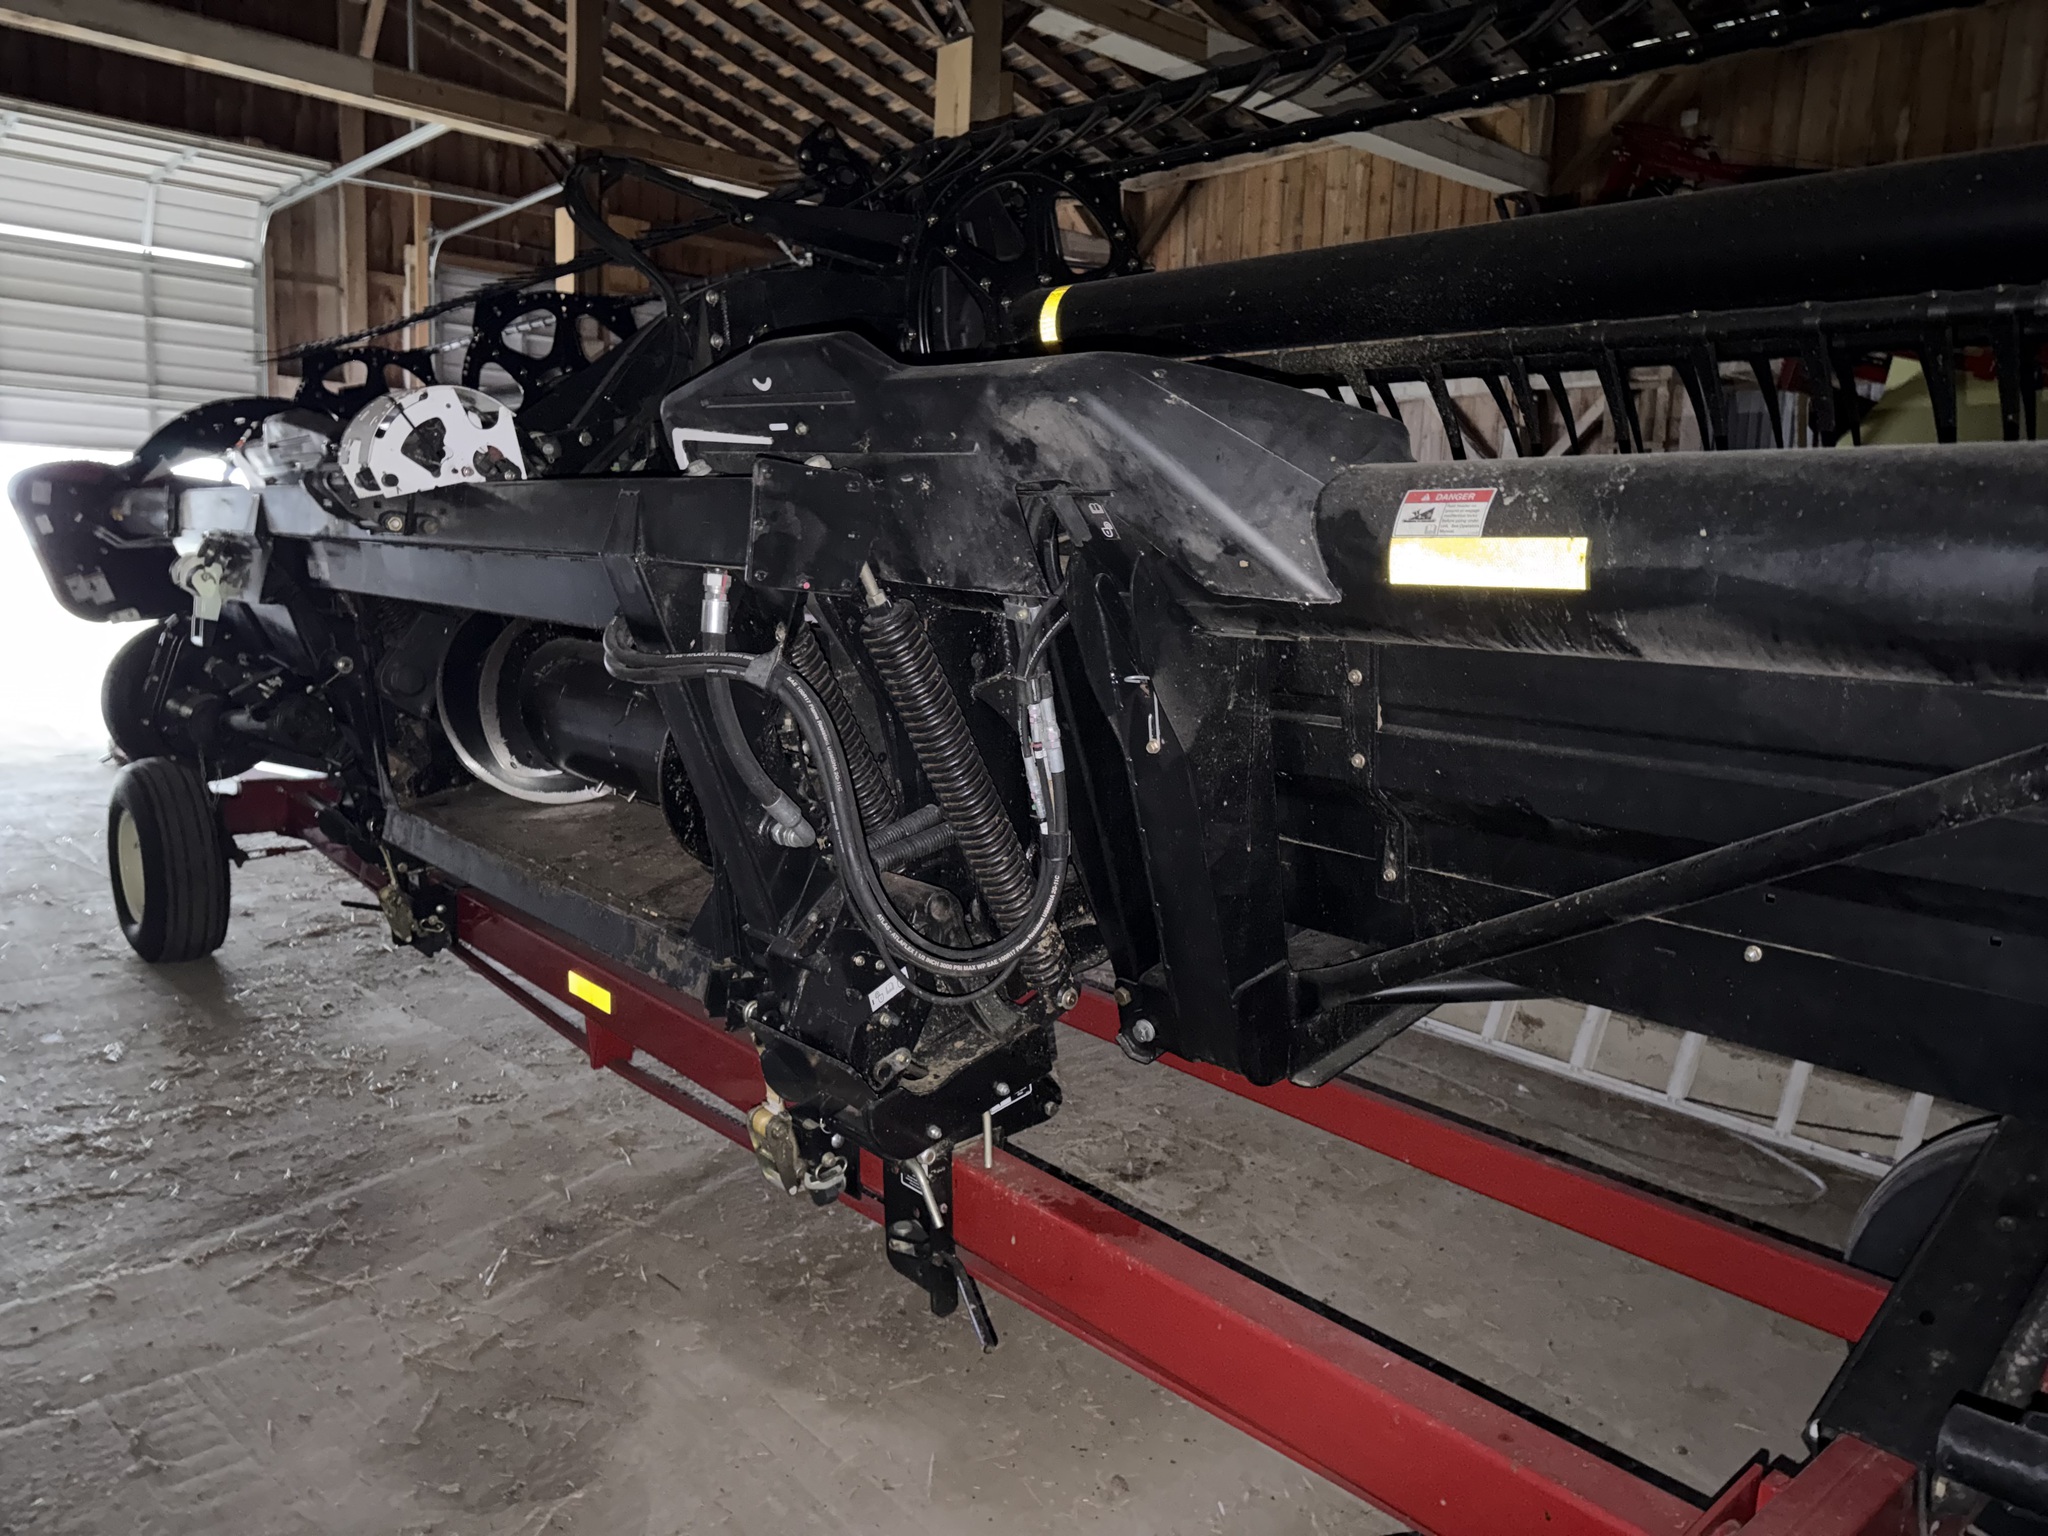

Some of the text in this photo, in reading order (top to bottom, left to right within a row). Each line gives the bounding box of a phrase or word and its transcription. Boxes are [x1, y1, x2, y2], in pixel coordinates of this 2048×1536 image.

[1435, 493, 1476, 501] DANGER
[787, 676, 797, 687] SAE
[877, 914, 890, 930] ATLAS
[891, 932, 915, 954] ATLAFLEX
[925, 957, 939, 967] INCH
[987, 959, 999, 967] SAE
